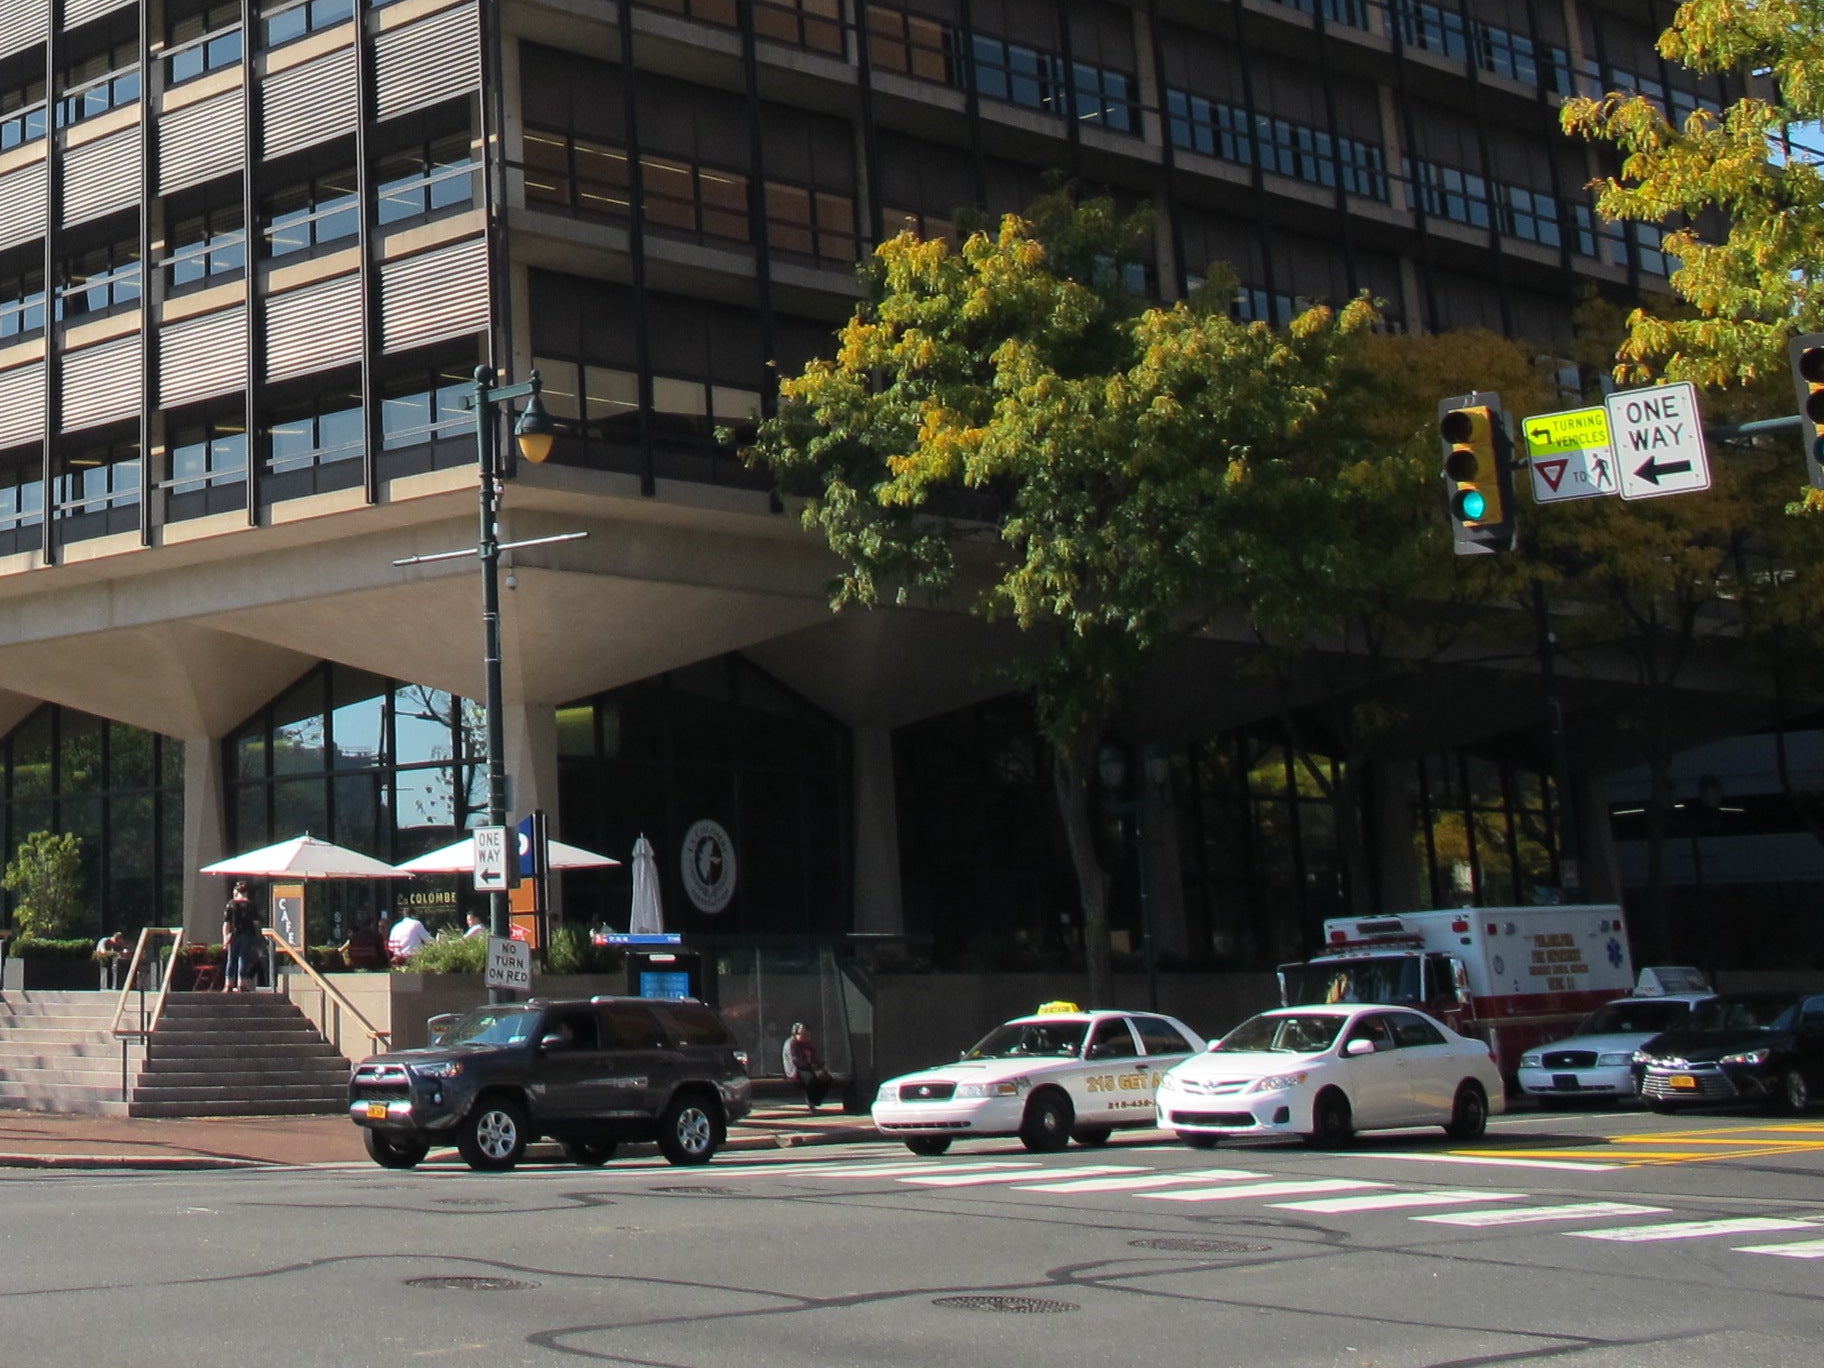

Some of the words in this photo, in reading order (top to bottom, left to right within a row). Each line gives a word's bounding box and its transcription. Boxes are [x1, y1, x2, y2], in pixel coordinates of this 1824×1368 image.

[1626, 395, 1680, 424] ONE
[1552, 414, 1603, 432] TURNING
[1556, 430, 1607, 448] VEHICLES
[1628, 422, 1684, 452] WAY
[1573, 470, 1587, 483] TO
[479, 833, 500, 847] ONE
[479, 849, 501, 863] WAY
[409, 891, 456, 905] COLOMBE
[278, 898, 296, 945] CAFE
[502, 943, 516, 954] NO
[495, 955, 523, 969] TURN
[489, 968, 504, 979] ON
[506, 969, 527, 982] RED
[1087, 1075, 1115, 1092] 215
[1118, 1074, 1148, 1090] GET
